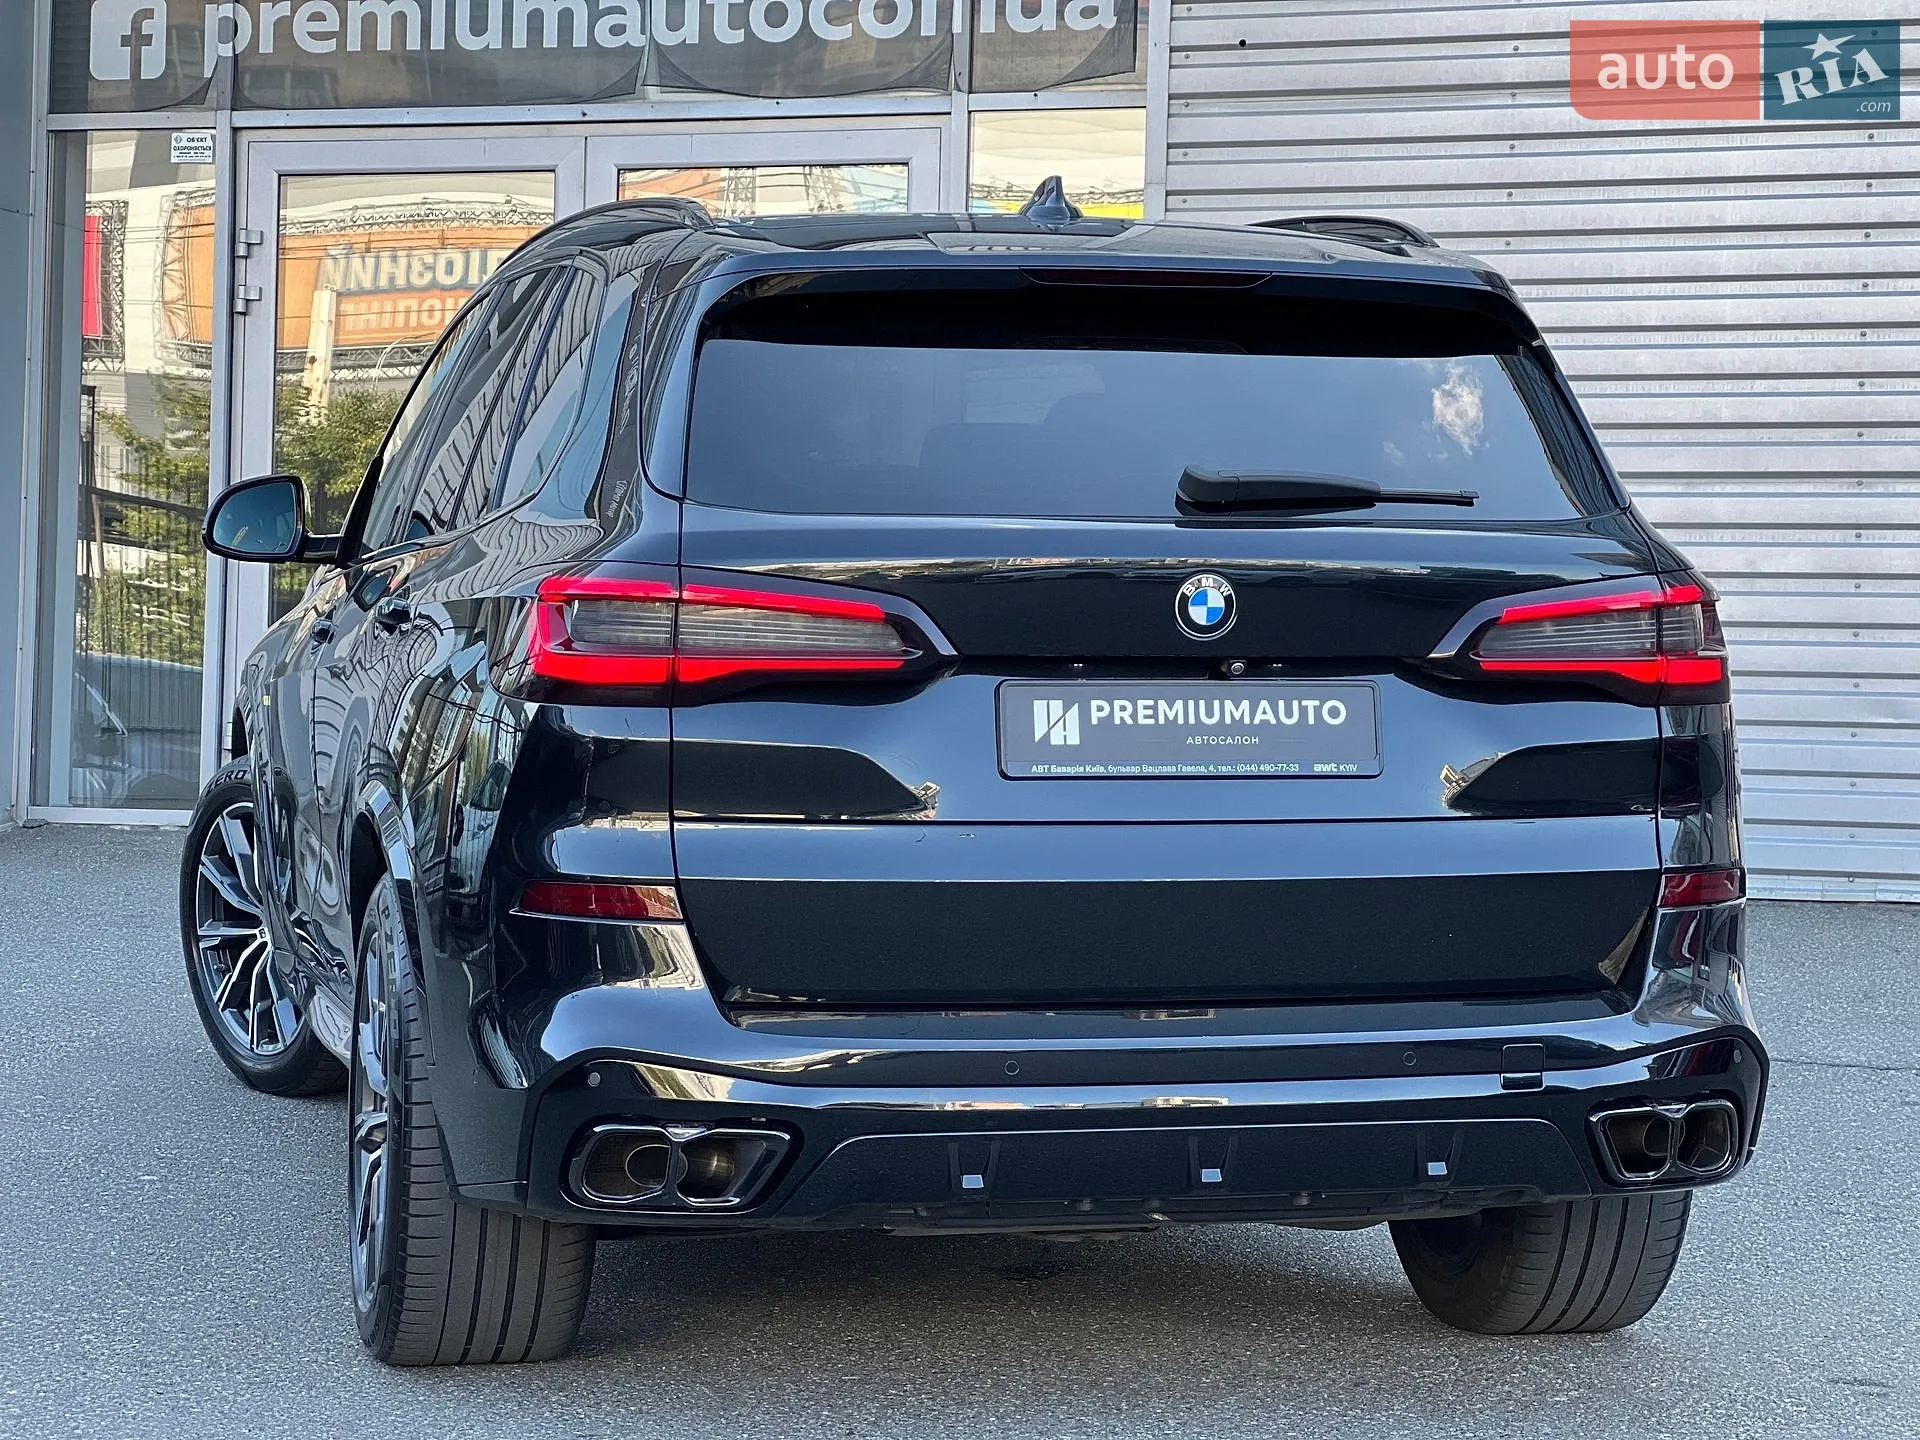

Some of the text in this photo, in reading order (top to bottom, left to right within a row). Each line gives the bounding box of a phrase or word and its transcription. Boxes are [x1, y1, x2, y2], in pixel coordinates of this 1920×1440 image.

[1182, 577, 1231, 597] BMW
[1090, 699, 1347, 726] PREMIUMAUTO
[1186, 735, 1259, 745] АВТОСАЛОН
[1108, 764, 1140, 774] бульвар
[1208, 764, 1217, 773] 4,
[1237, 763, 1258, 773] (044)
[1259, 763, 1299, 772] 490-77-33
[1313, 762, 1338, 772] awt
